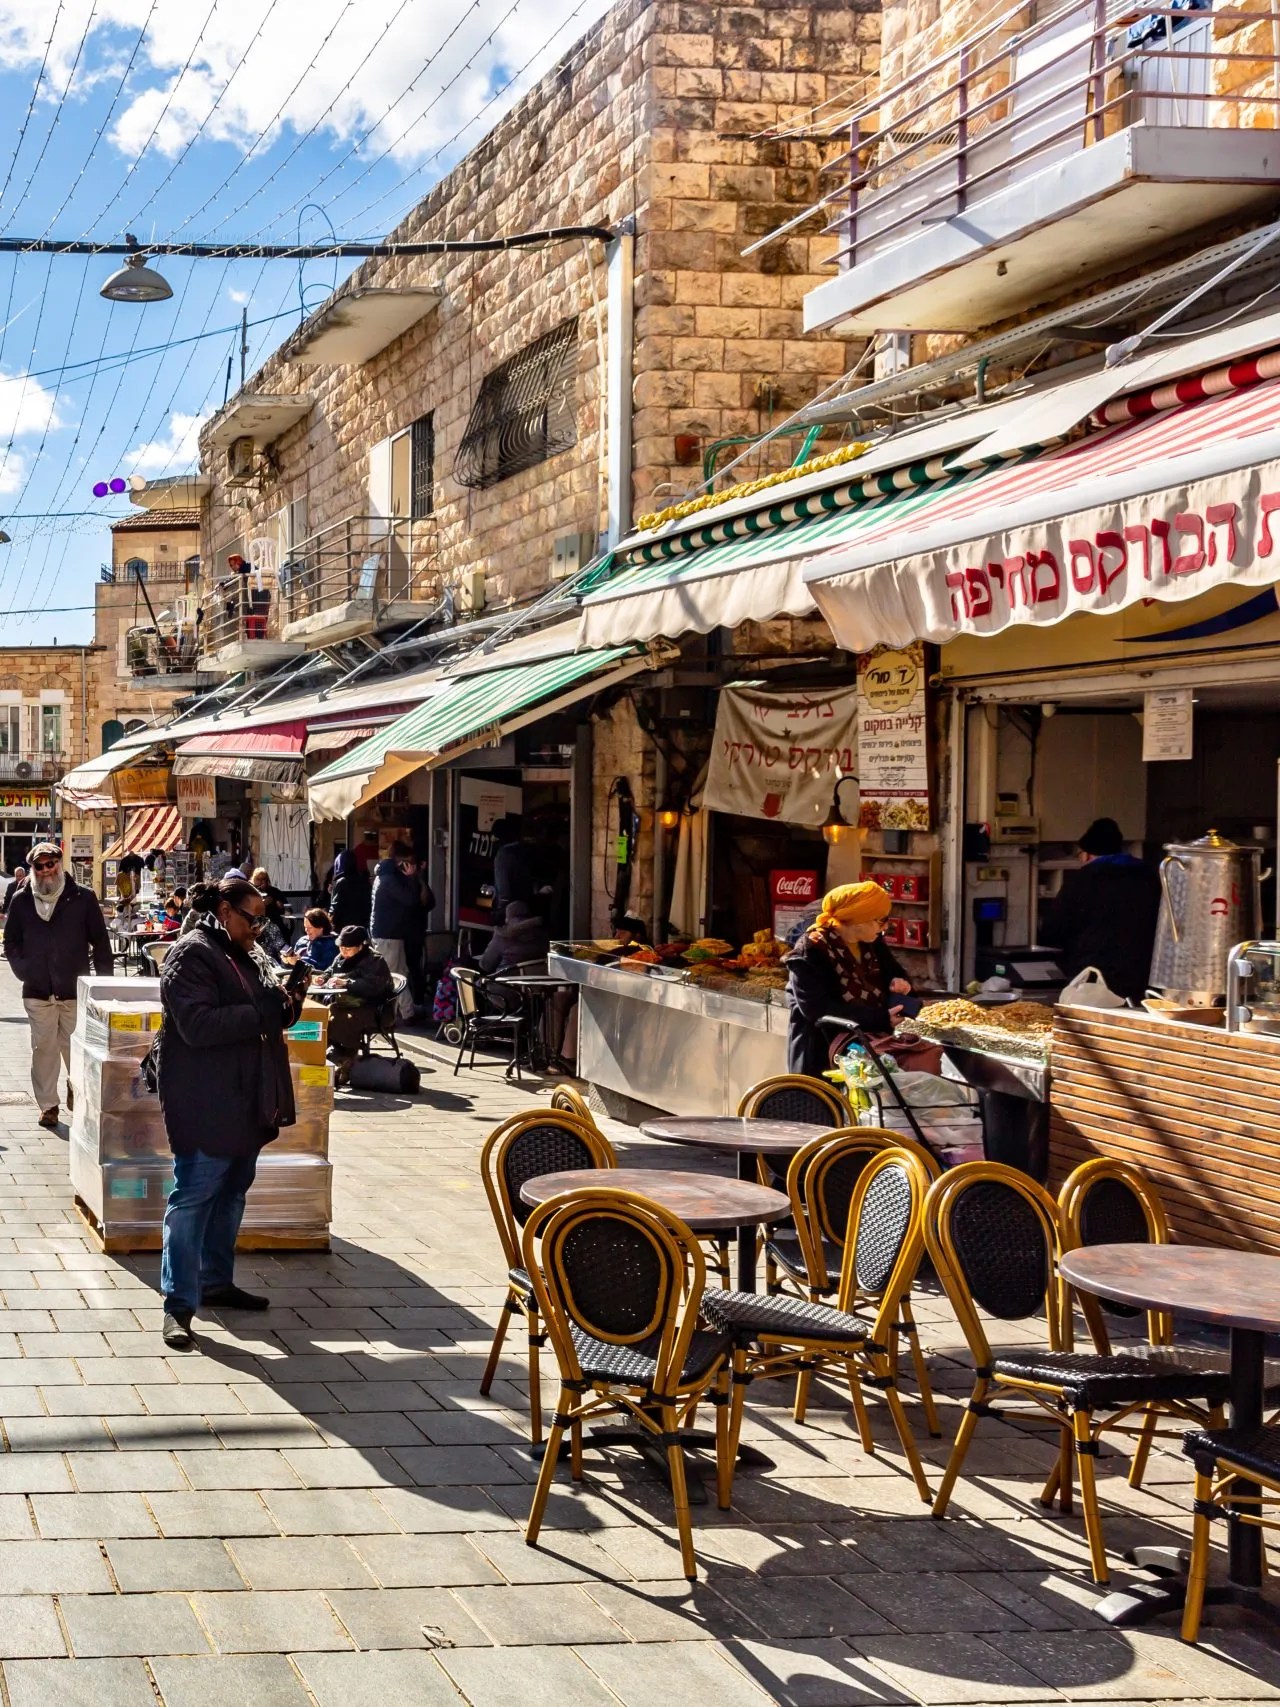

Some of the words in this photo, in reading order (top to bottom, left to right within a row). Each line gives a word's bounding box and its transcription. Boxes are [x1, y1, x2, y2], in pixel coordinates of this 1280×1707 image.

[1069, 503, 1237, 596] הבורקס
[945, 550, 1060, 622] מחיפה
[864, 719, 893, 735] במקום
